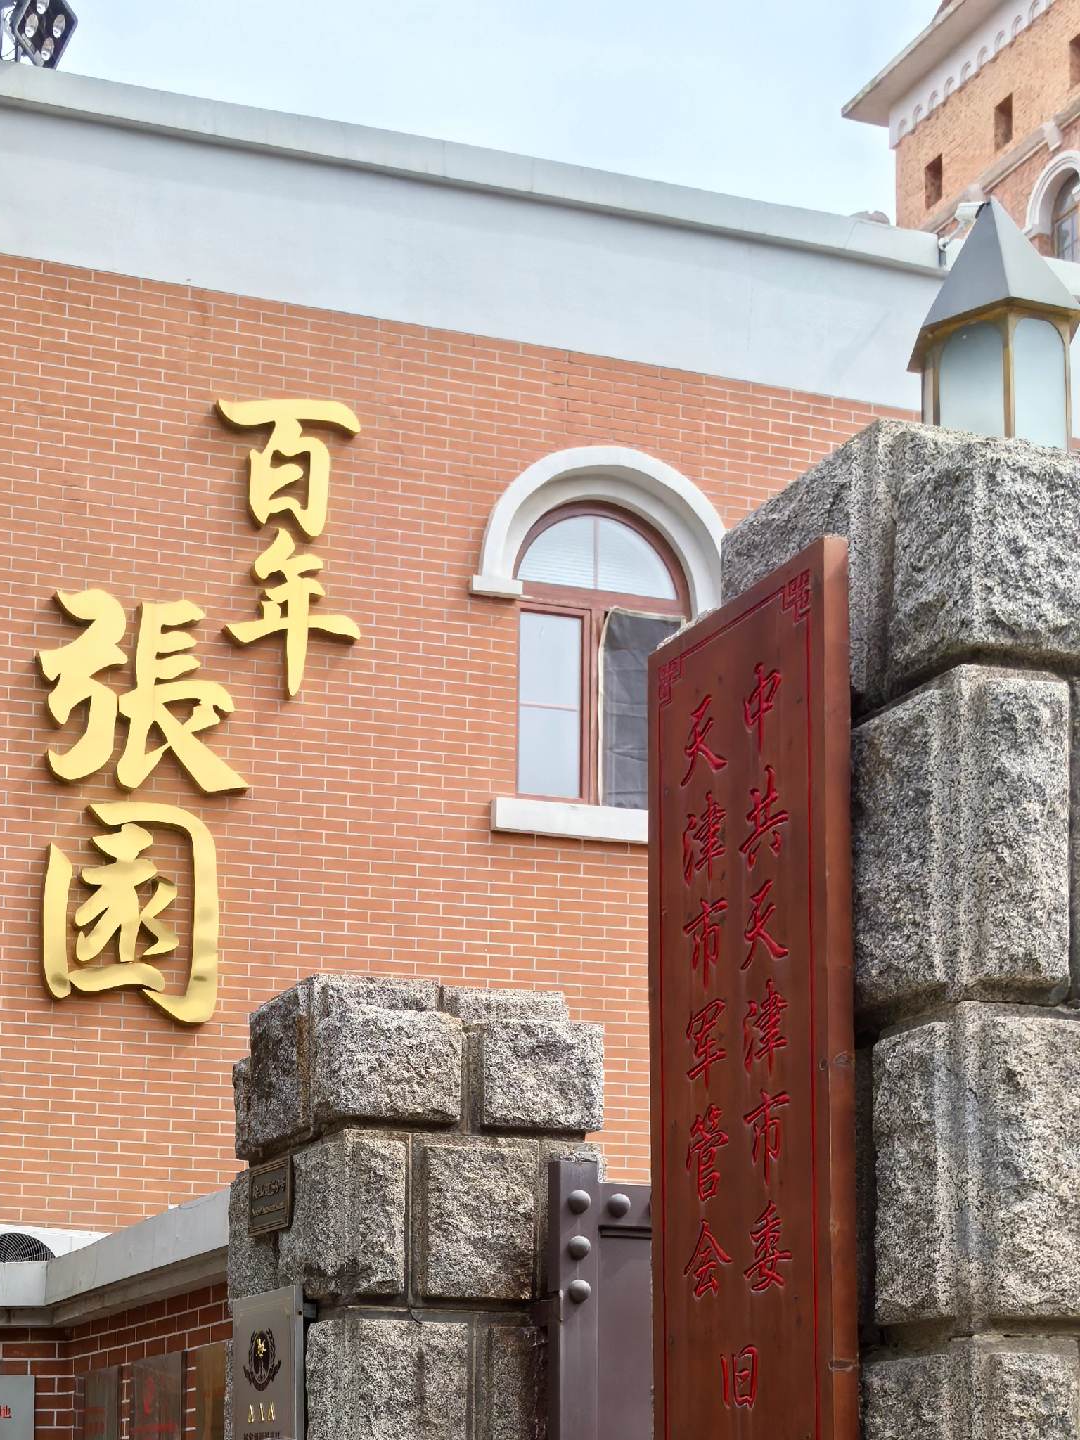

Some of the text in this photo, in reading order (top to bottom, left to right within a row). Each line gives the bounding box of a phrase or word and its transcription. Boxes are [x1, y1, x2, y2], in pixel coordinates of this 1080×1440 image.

[216, 399, 362, 697] 百年
[738, 661, 793, 1294] 中共天津市委
